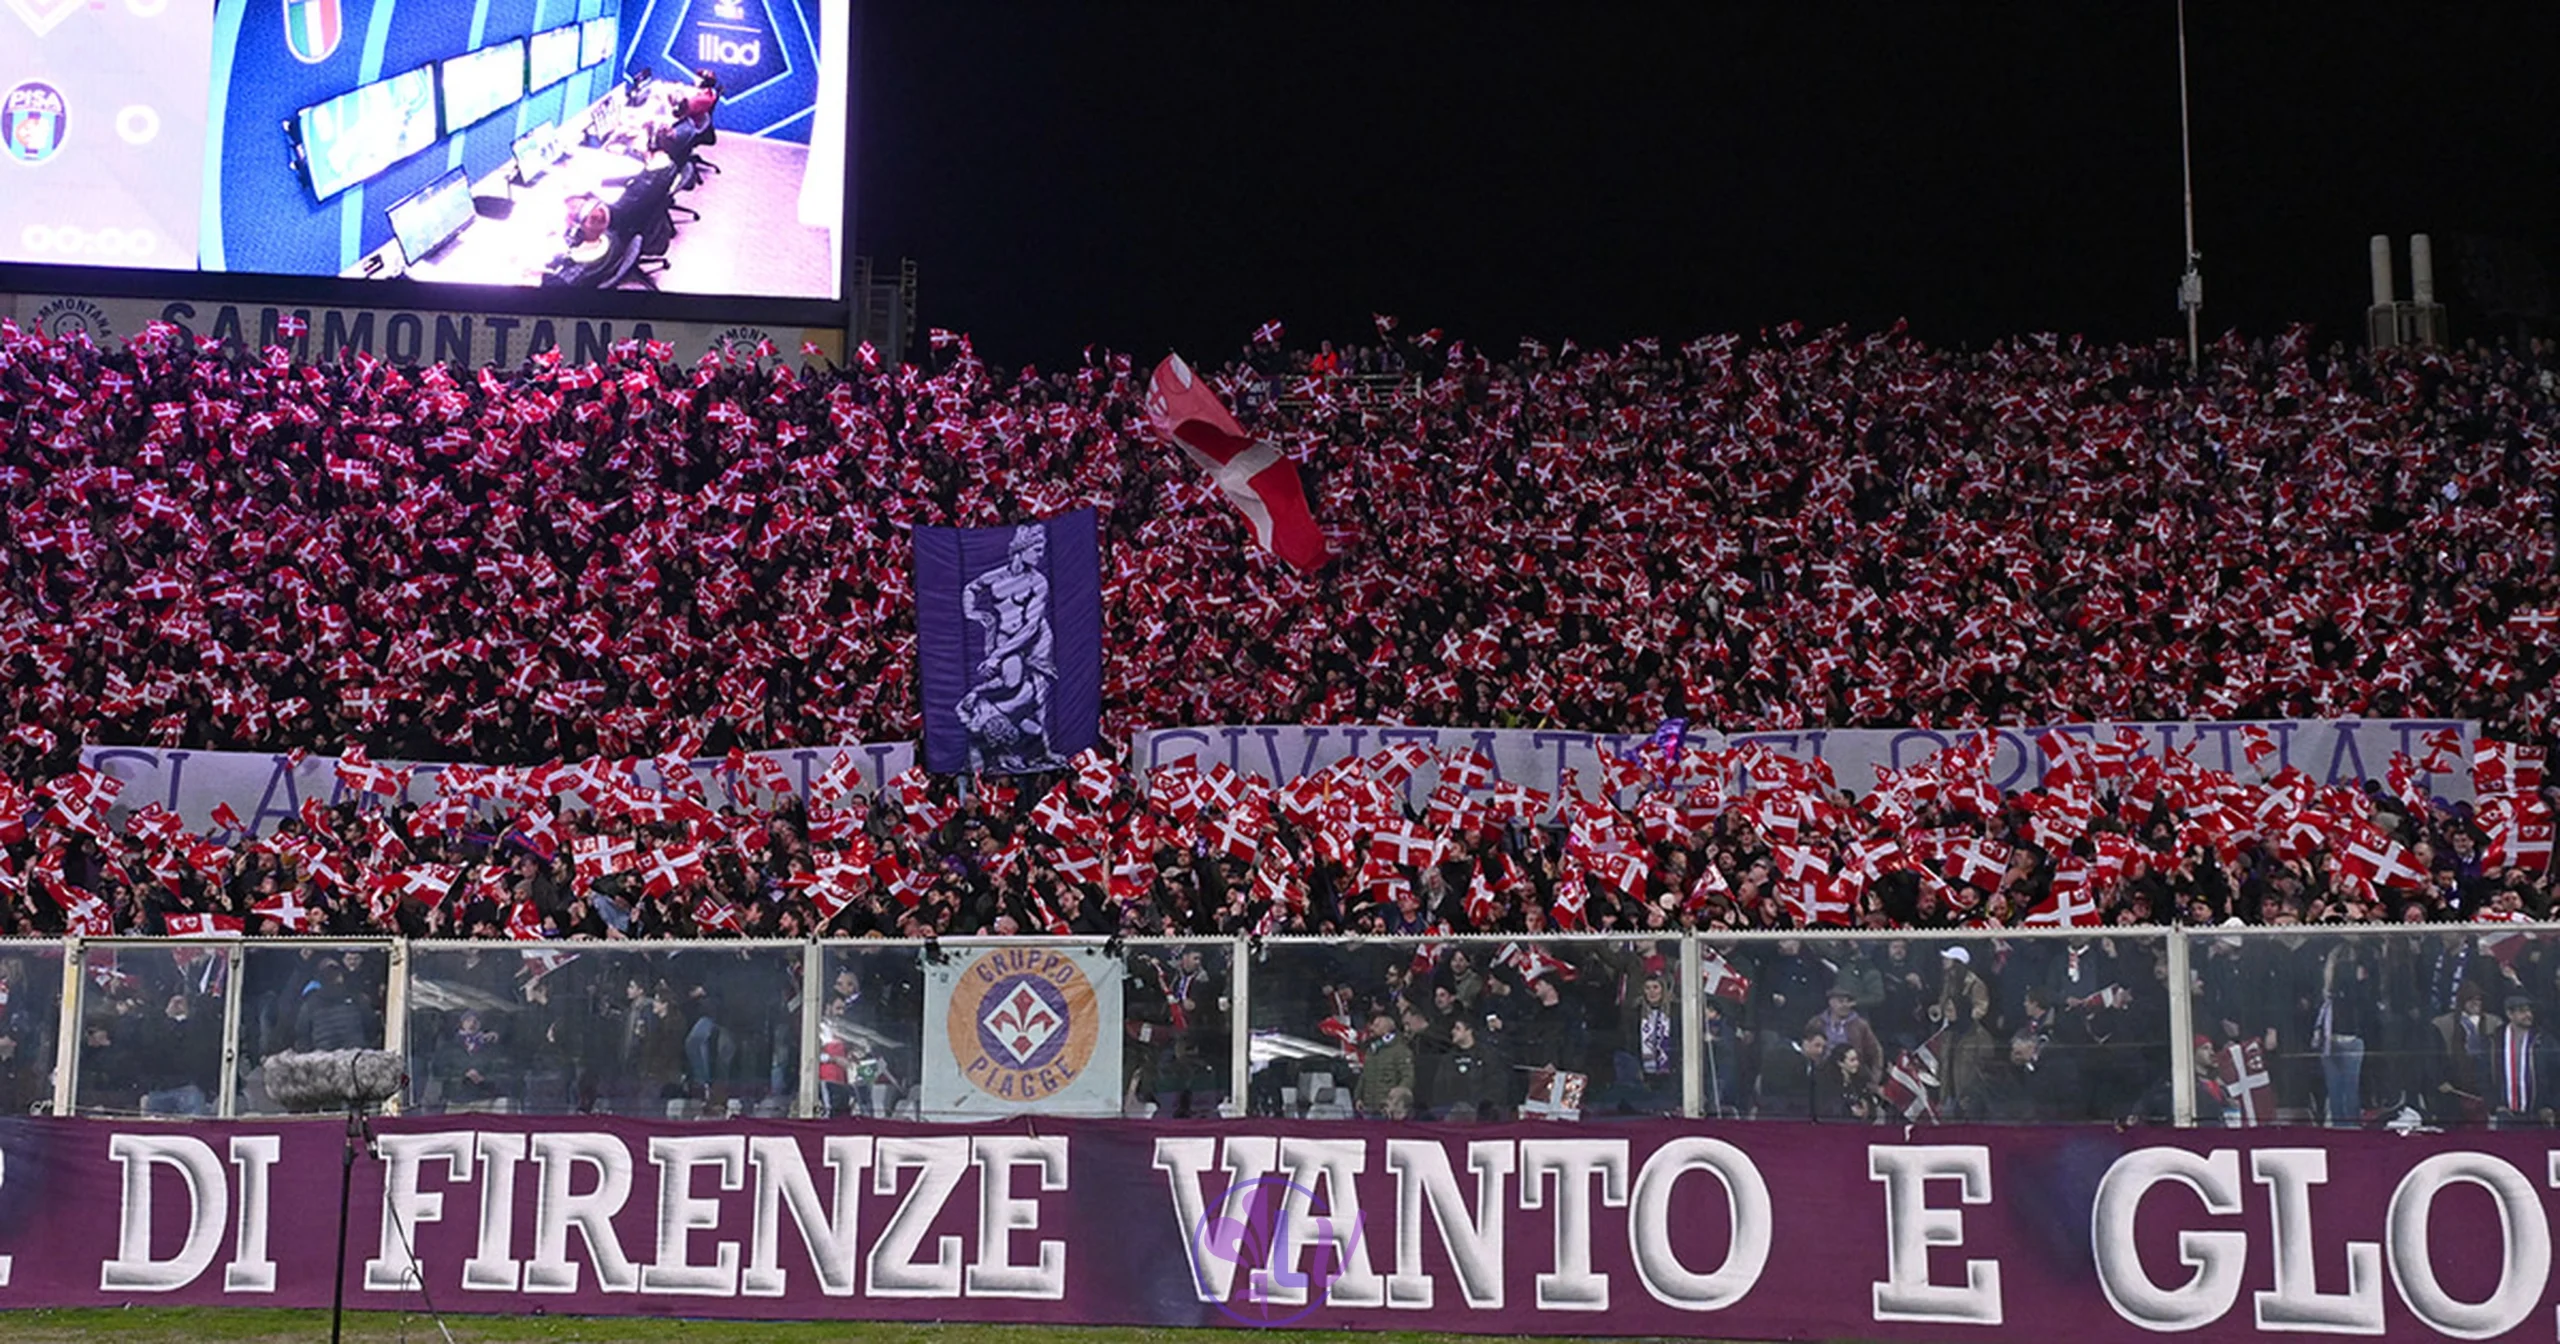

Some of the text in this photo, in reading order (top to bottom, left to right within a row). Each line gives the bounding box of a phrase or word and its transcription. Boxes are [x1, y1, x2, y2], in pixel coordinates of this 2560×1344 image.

[974, 949, 1074, 984] GRUPPO
[967, 1055, 1076, 1098] PIAGGE
[101, 1133, 281, 1292] DI
[364, 1131, 1069, 1298] FIRENZE
[1153, 1136, 1772, 1311] VANTO
[1868, 1145, 2003, 1324] E
[2091, 1146, 2560, 1341] GLO
